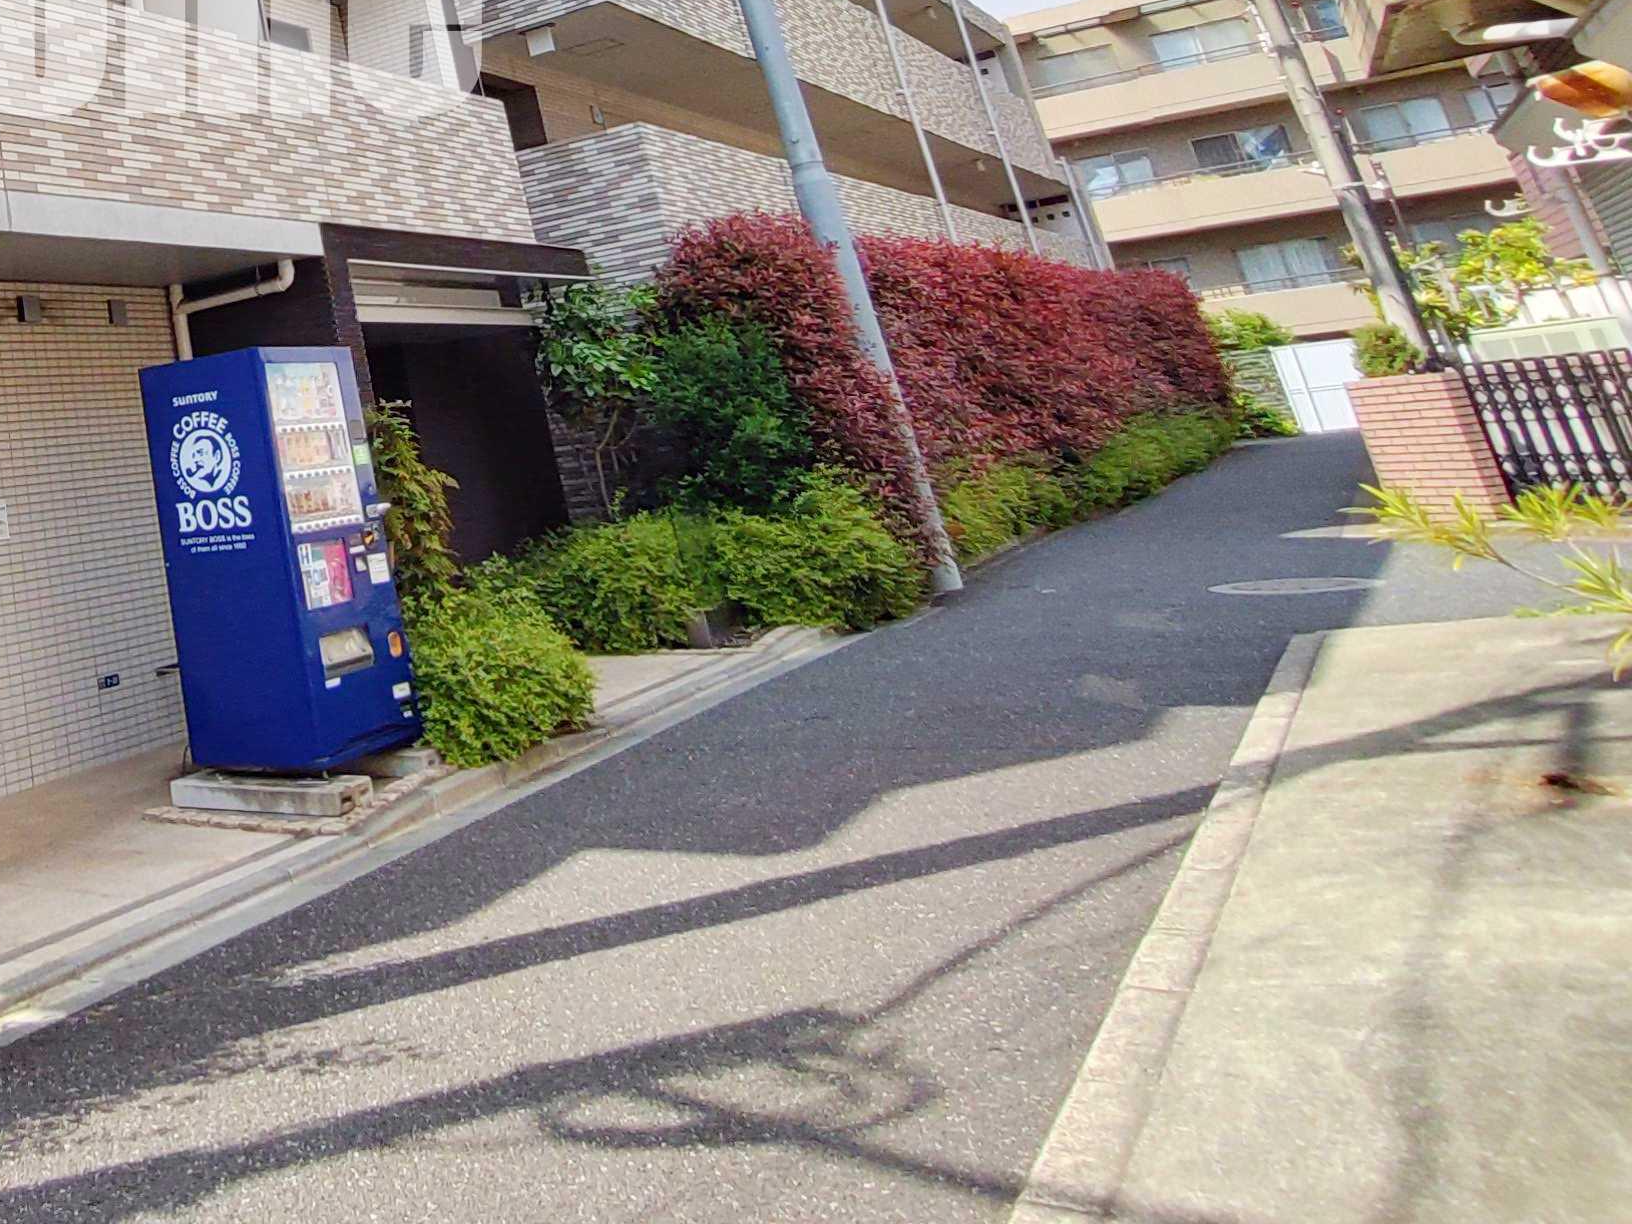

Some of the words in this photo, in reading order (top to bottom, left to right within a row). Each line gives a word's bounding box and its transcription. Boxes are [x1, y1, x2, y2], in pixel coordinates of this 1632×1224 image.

[172, 390, 218, 407] SUNTORY
[173, 411, 228, 439] COFFEE
[175, 495, 252, 532] BOSS
